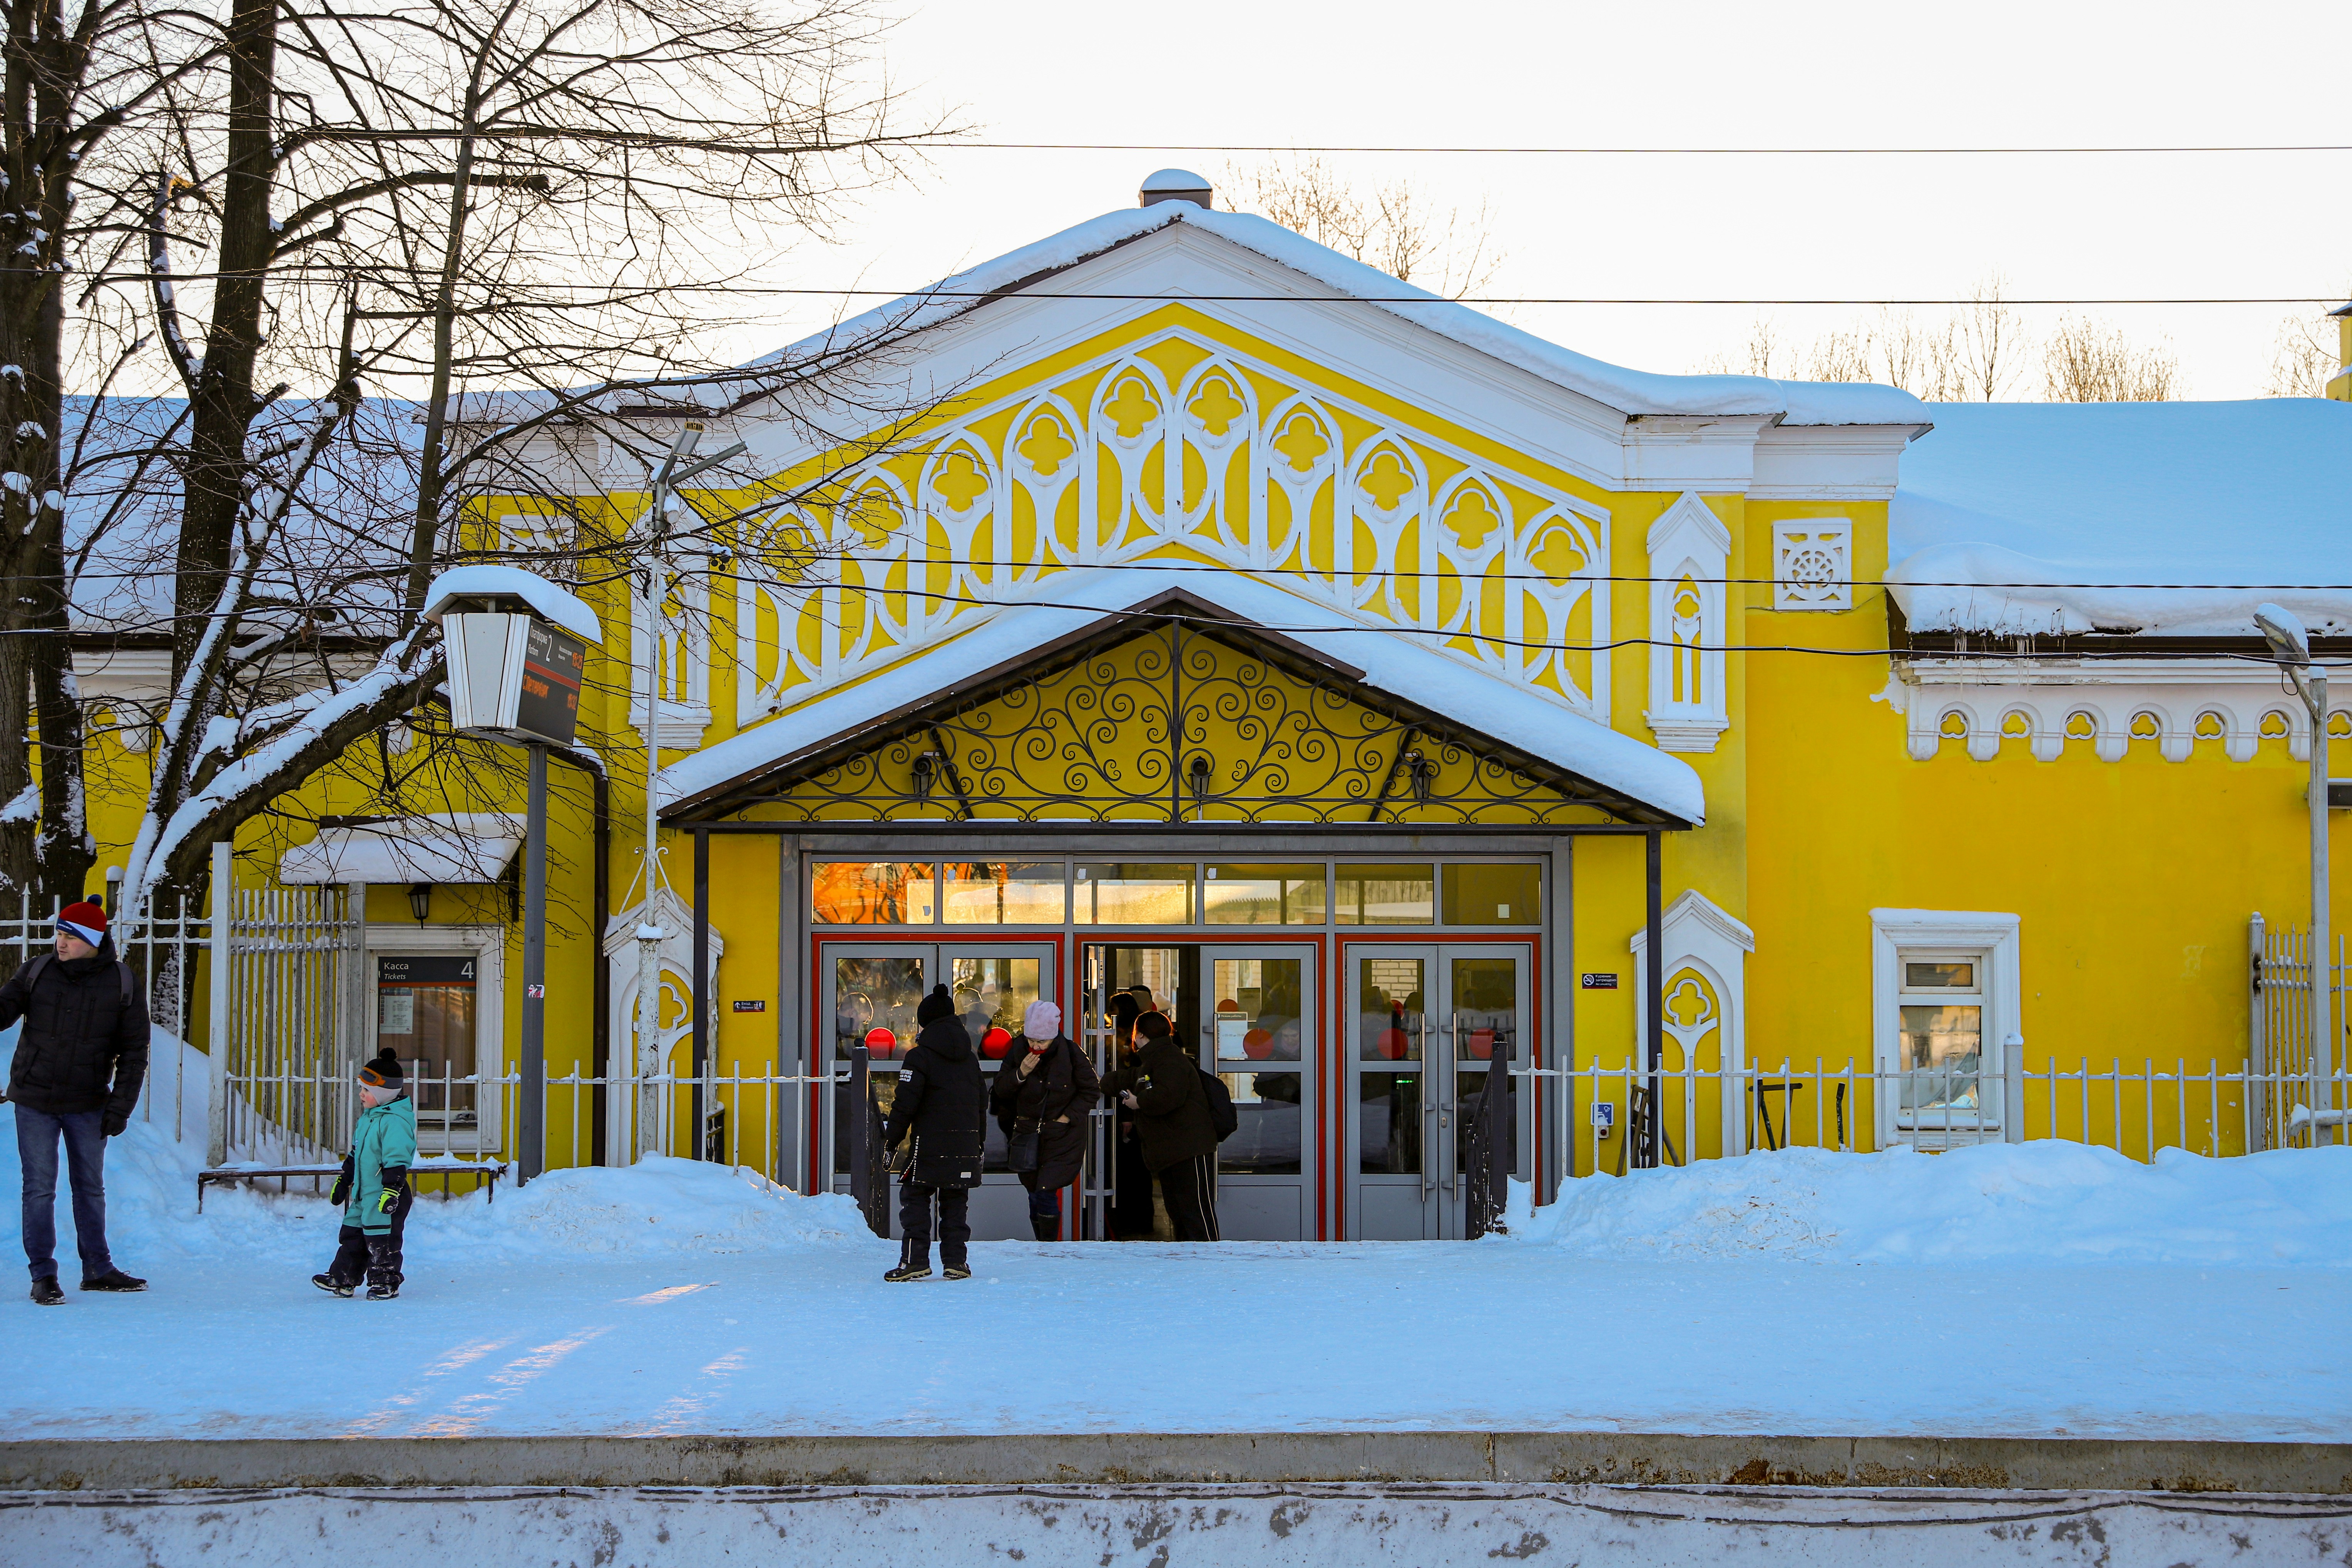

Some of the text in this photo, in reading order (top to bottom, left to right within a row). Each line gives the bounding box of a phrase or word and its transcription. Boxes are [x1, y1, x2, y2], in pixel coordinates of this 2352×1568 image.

[530, 625, 548, 645] Платформа
[527, 644, 539, 656] Platform
[545, 634, 552, 662] 2
[461, 961, 474, 979] 4
